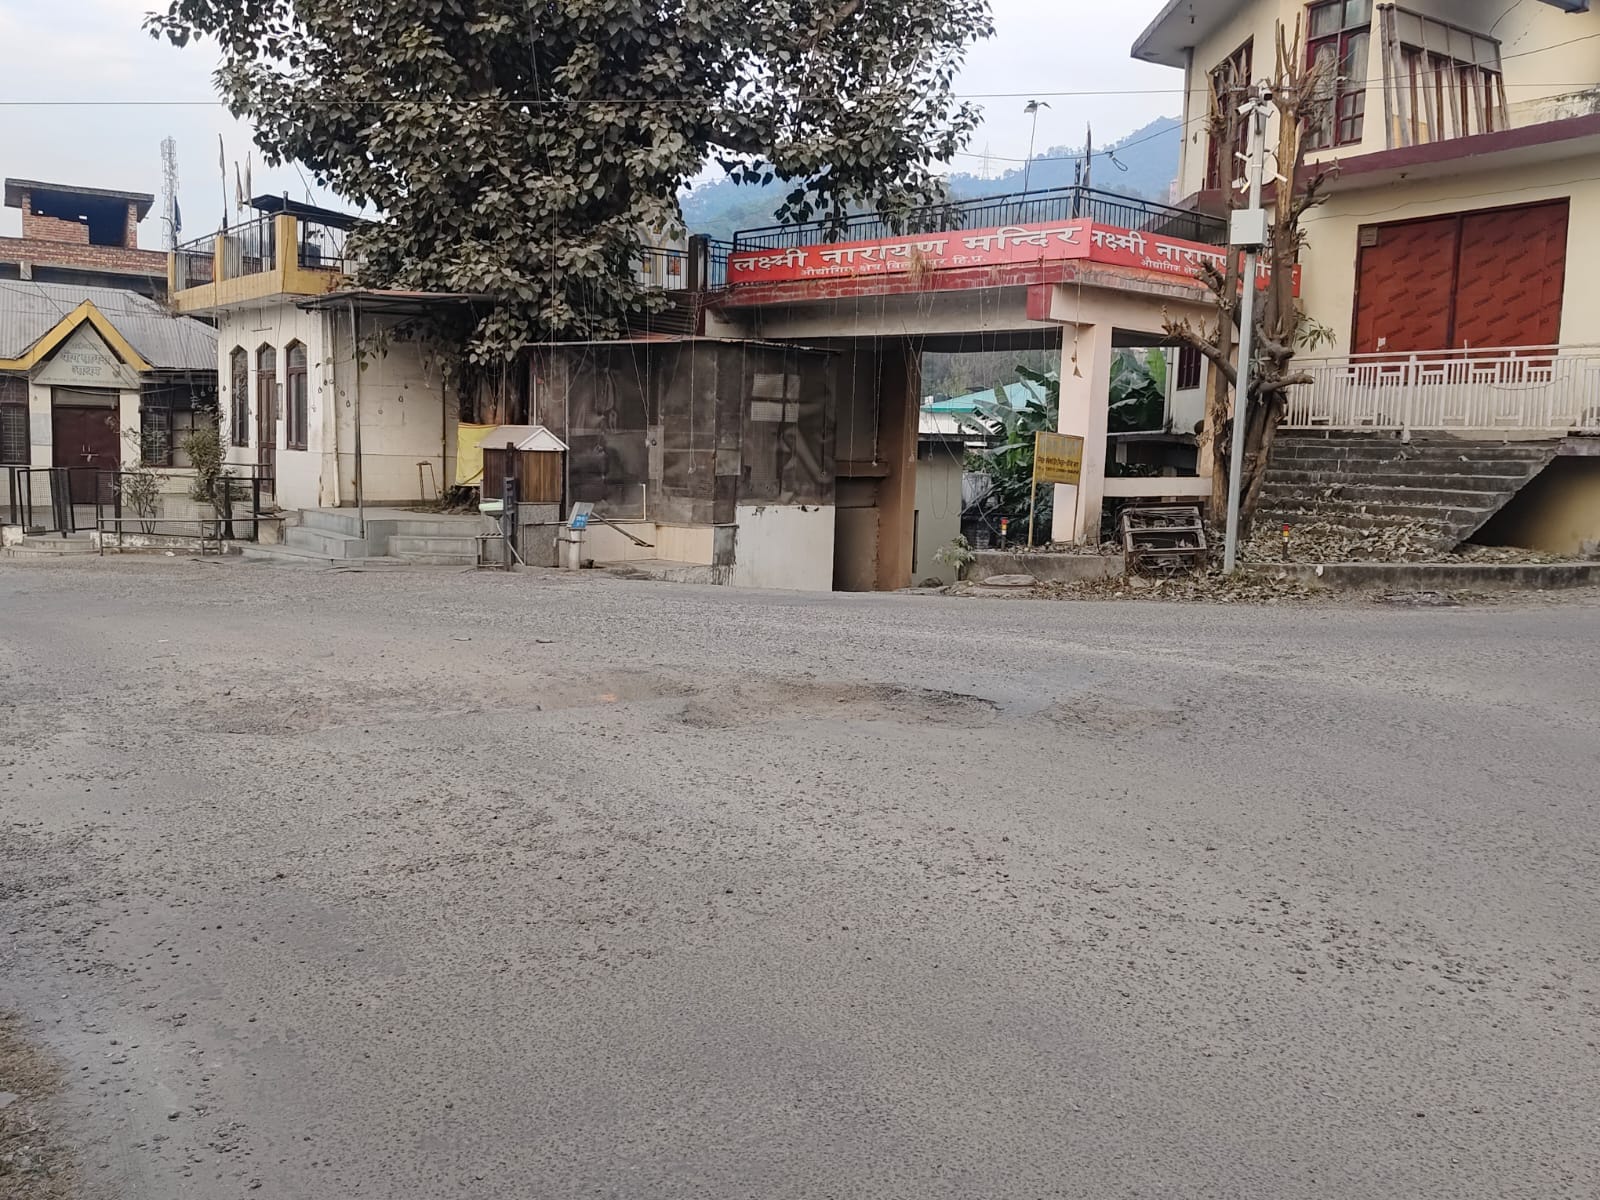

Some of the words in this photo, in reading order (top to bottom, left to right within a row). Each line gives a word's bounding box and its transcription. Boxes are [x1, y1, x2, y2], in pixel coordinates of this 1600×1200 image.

[732, 247, 808, 272] लक्ष्मी
[820, 240, 948, 264] नारायण
[962, 226, 1082, 252] मन्दिर
